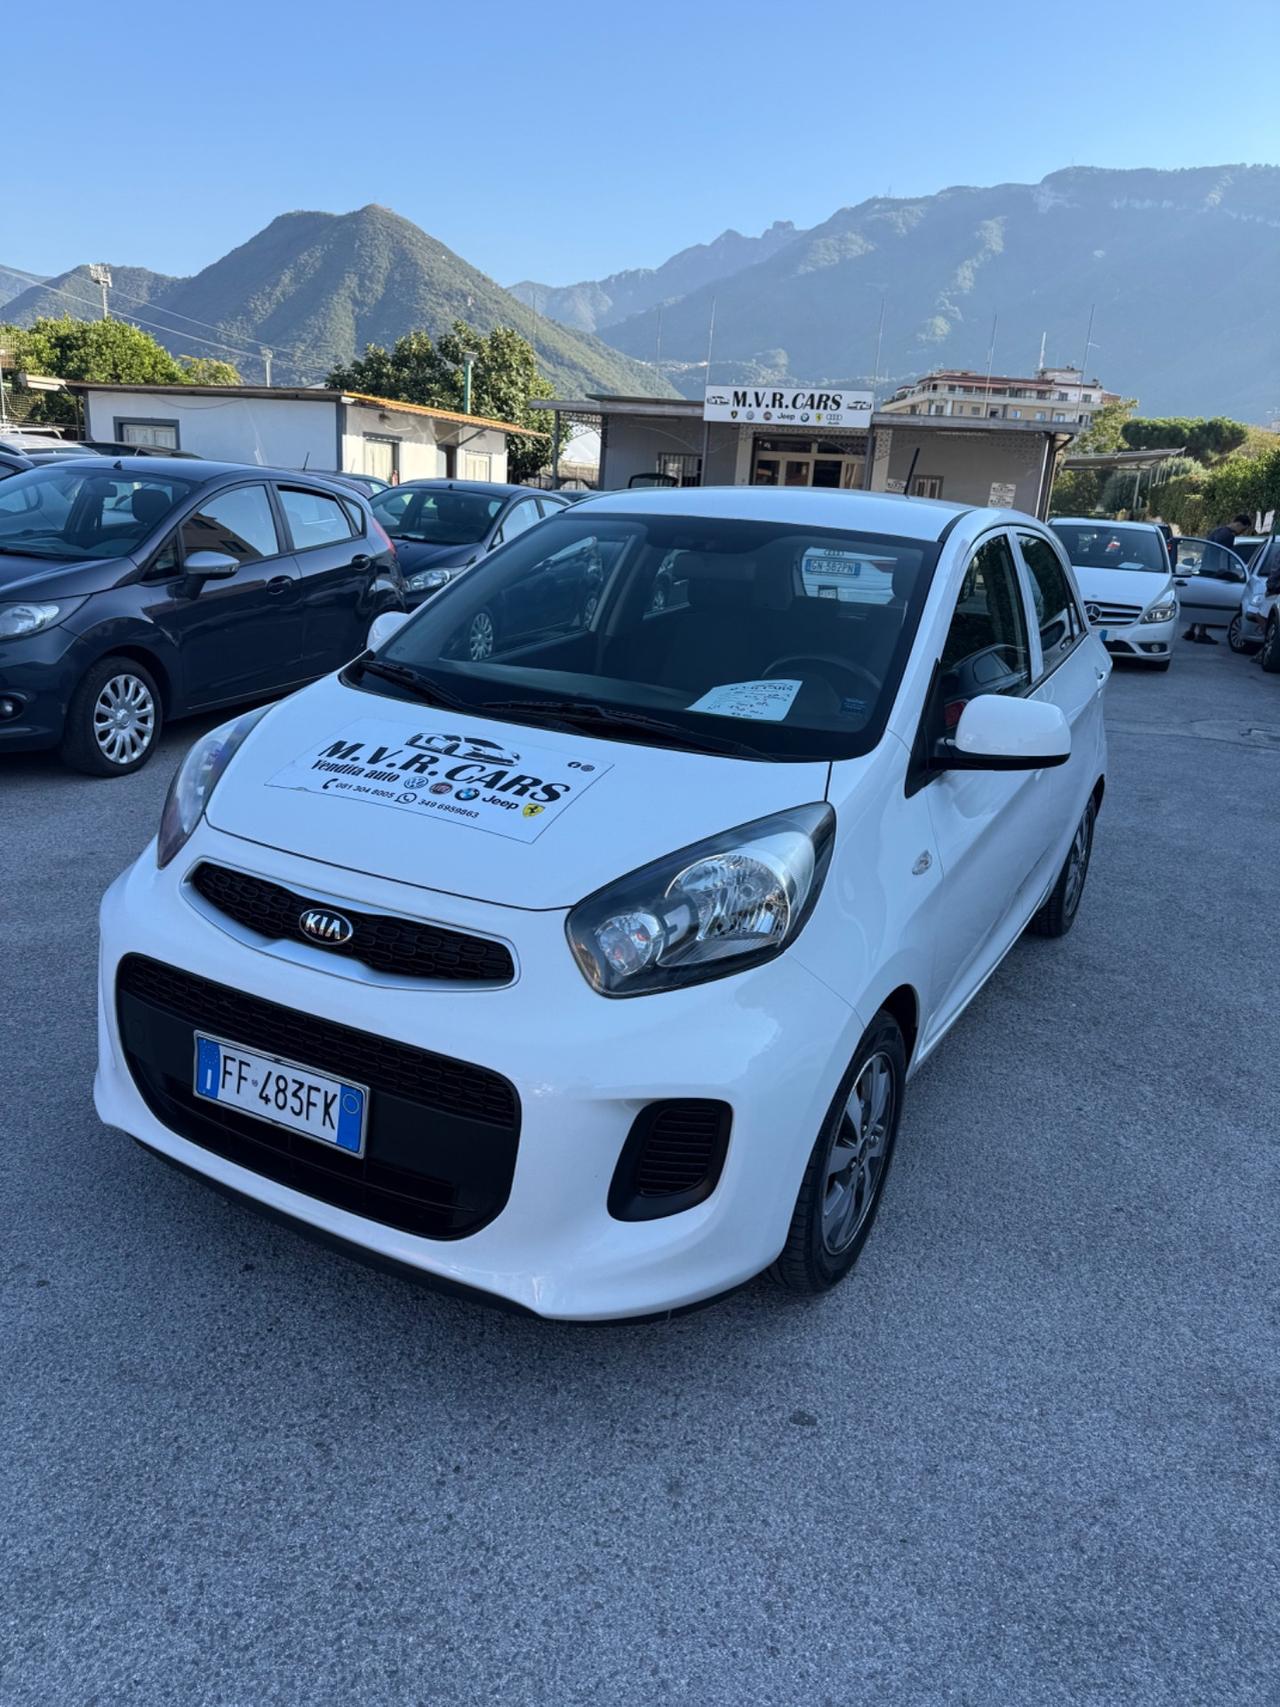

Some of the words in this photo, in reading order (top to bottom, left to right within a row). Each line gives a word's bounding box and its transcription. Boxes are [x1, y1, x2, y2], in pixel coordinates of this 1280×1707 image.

[311, 759, 365, 777] Vendita
[364, 769, 401, 783] auto
[335, 782, 353, 790] 081
[418, 798, 438, 808] 349
[482, 795, 520, 811] Jeep
[304, 912, 341, 940] KIA
[221, 1055, 251, 1094] FF
[258, 1070, 338, 1130] 483FK
